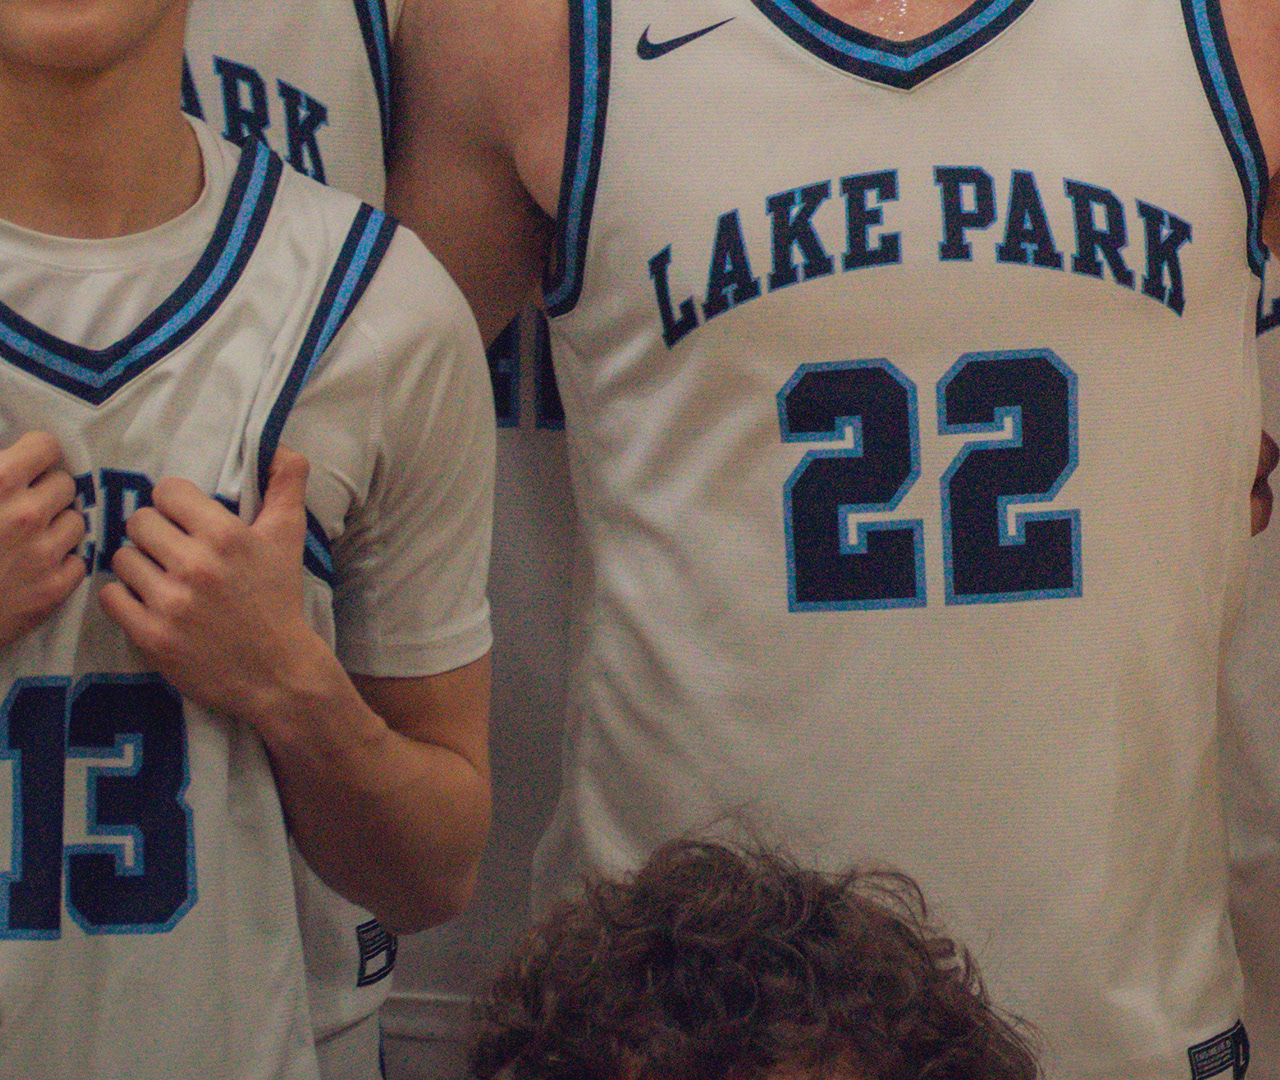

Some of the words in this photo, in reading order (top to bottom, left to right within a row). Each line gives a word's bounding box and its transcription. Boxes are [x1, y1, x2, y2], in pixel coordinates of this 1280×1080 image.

[648, 168, 902, 350] LAKE
[932, 164, 1193, 318] PARK
[776, 347, 1083, 613] 22
[0, 672, 198, 940] 13
